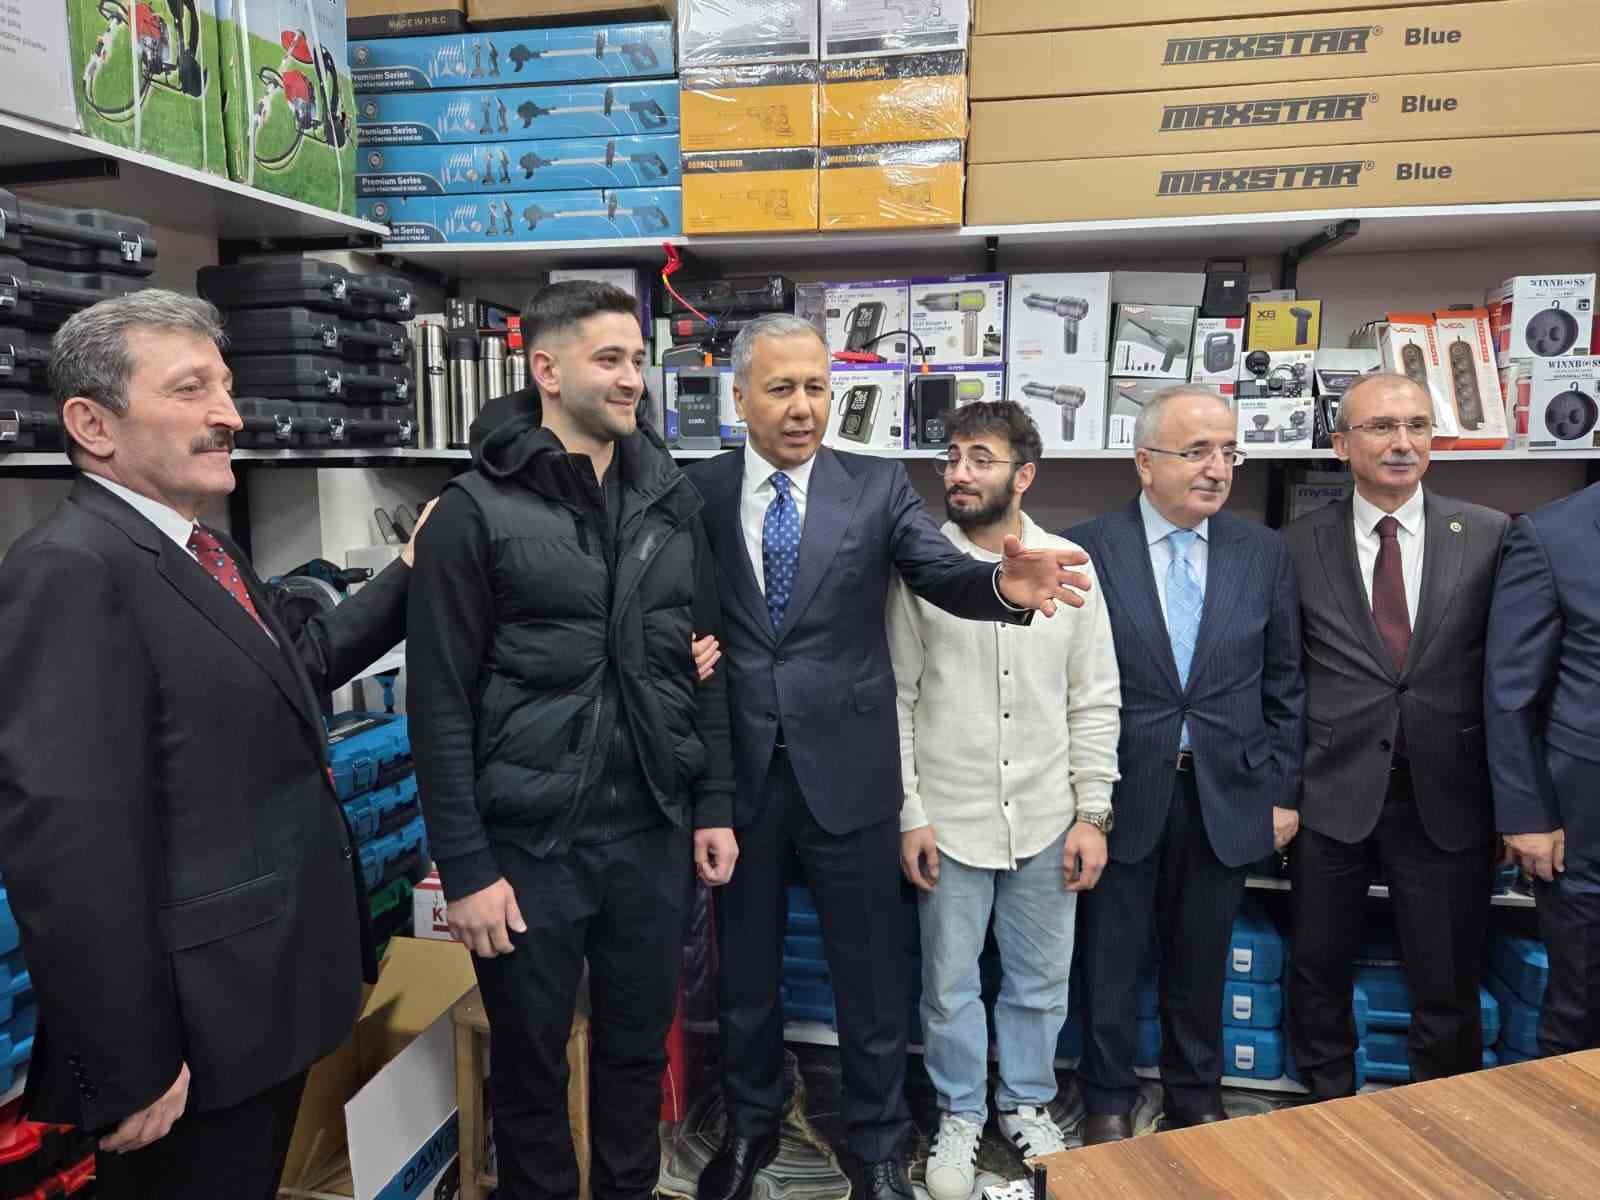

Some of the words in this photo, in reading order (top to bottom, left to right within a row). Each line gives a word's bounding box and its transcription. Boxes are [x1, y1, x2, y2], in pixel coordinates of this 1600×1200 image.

[1404, 28, 1463, 46] Blue
[384, 71, 409, 80] Series
[1400, 94, 1459, 113] Blue
[392, 126, 418, 135] Series
[1396, 162, 1453, 181] Blue
[362, 177, 397, 186] Premium
[397, 176, 422, 185] Series
[400, 226, 425, 235] Series
